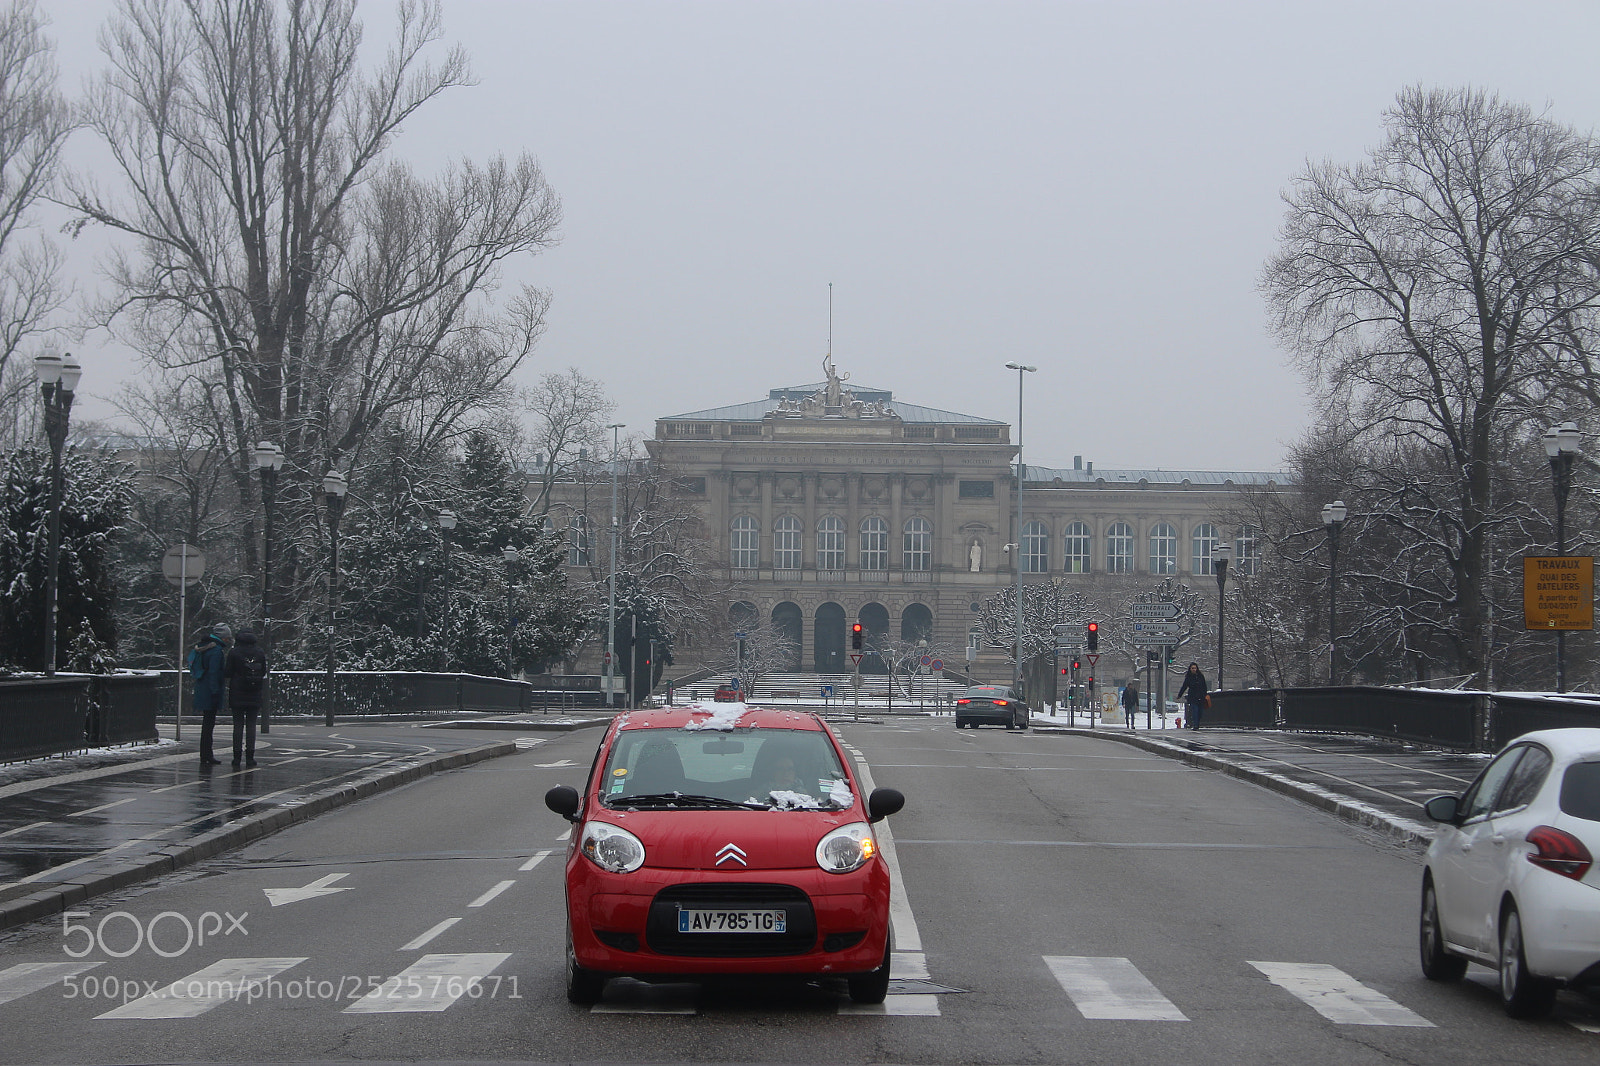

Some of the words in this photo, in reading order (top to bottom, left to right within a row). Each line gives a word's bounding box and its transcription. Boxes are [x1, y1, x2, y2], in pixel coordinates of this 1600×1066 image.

[1537, 560, 1580, 569] TRAVAUX
[1540, 574, 1558, 582] QUAI
[1546, 594, 1566, 603] partir
[1538, 602, 1579, 610] 03/04/2017
[775, 921, 784, 931] 67
